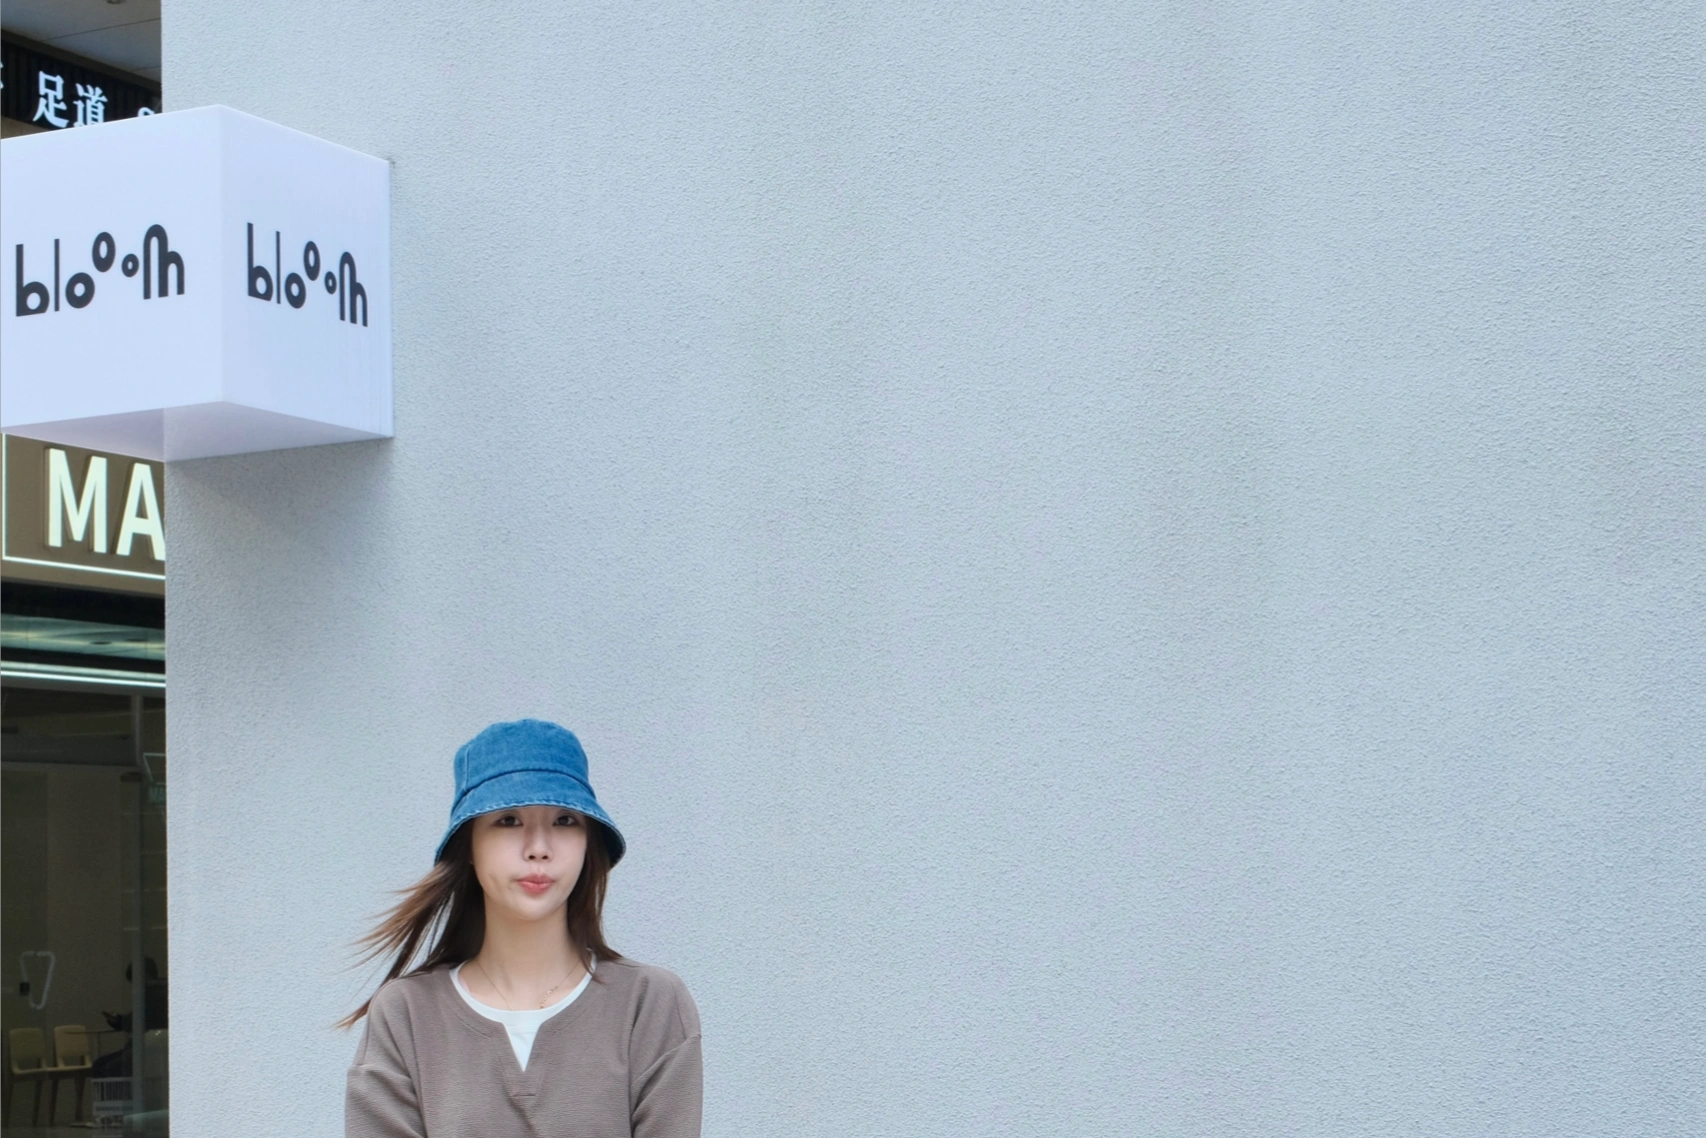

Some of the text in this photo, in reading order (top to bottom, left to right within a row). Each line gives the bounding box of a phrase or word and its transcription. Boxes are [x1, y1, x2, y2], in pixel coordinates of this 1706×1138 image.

[32, 70, 108, 128] 足道
[16, 224, 185, 317] bloom
[247, 222, 368, 327] bloom
[47, 448, 165, 561] MA
